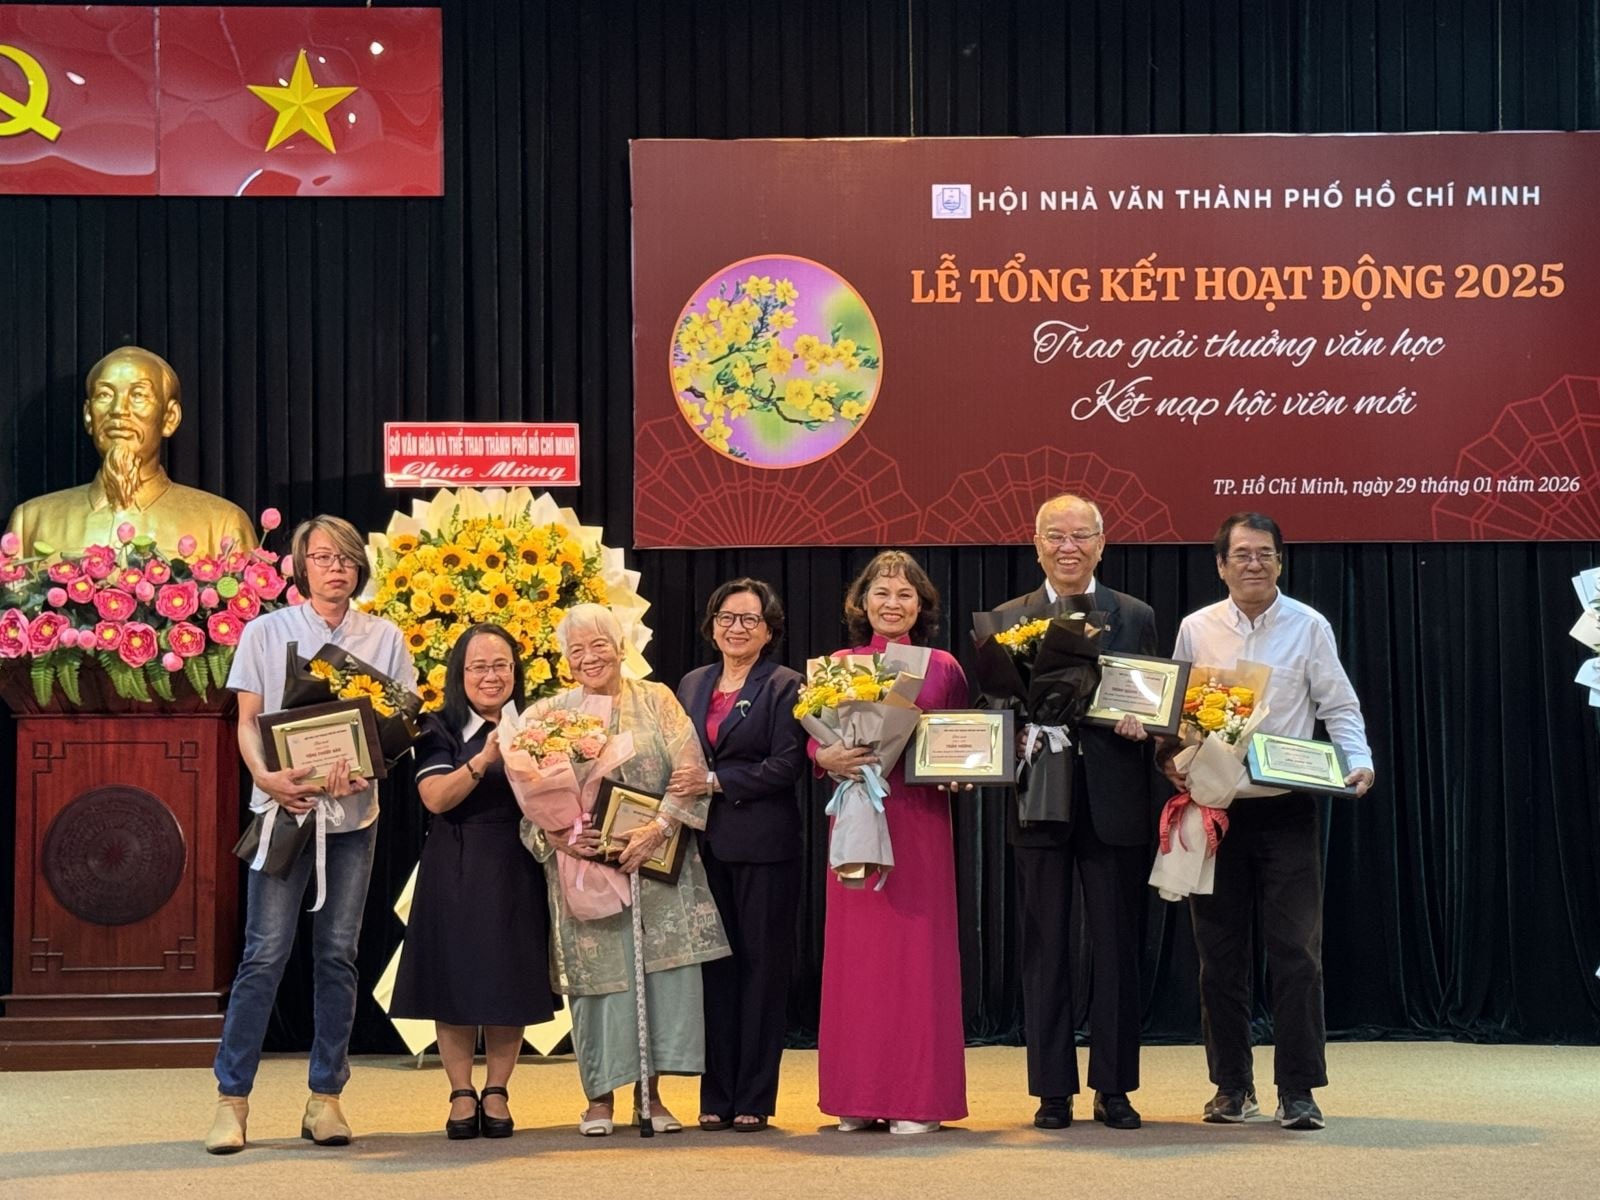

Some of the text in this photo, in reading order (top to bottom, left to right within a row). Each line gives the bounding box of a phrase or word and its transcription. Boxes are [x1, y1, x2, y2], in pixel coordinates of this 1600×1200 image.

[978, 178, 1540, 215] HỘI NHÀ VĂN THÀNH PHỐ HỒ CHÍ MINH
[910, 252, 1565, 312] LỄ TỔNG KẾT HOẠT ĐỘNG 2025
[1033, 320, 1446, 368] Trao giải thưởng văn học
[1070, 376, 1418, 426] Kết nạp hội viên mới
[389, 428, 576, 456] SỞ VĂN HÓA VÀ THỂ THAO THÀNH PHỐ HỒ CHÍ MINH
[401, 461, 567, 481] Chúc Mừng
[1213, 475, 1580, 499] TP. Hồ Chí Minh, ngày 29 tháng 01 năm 2026
